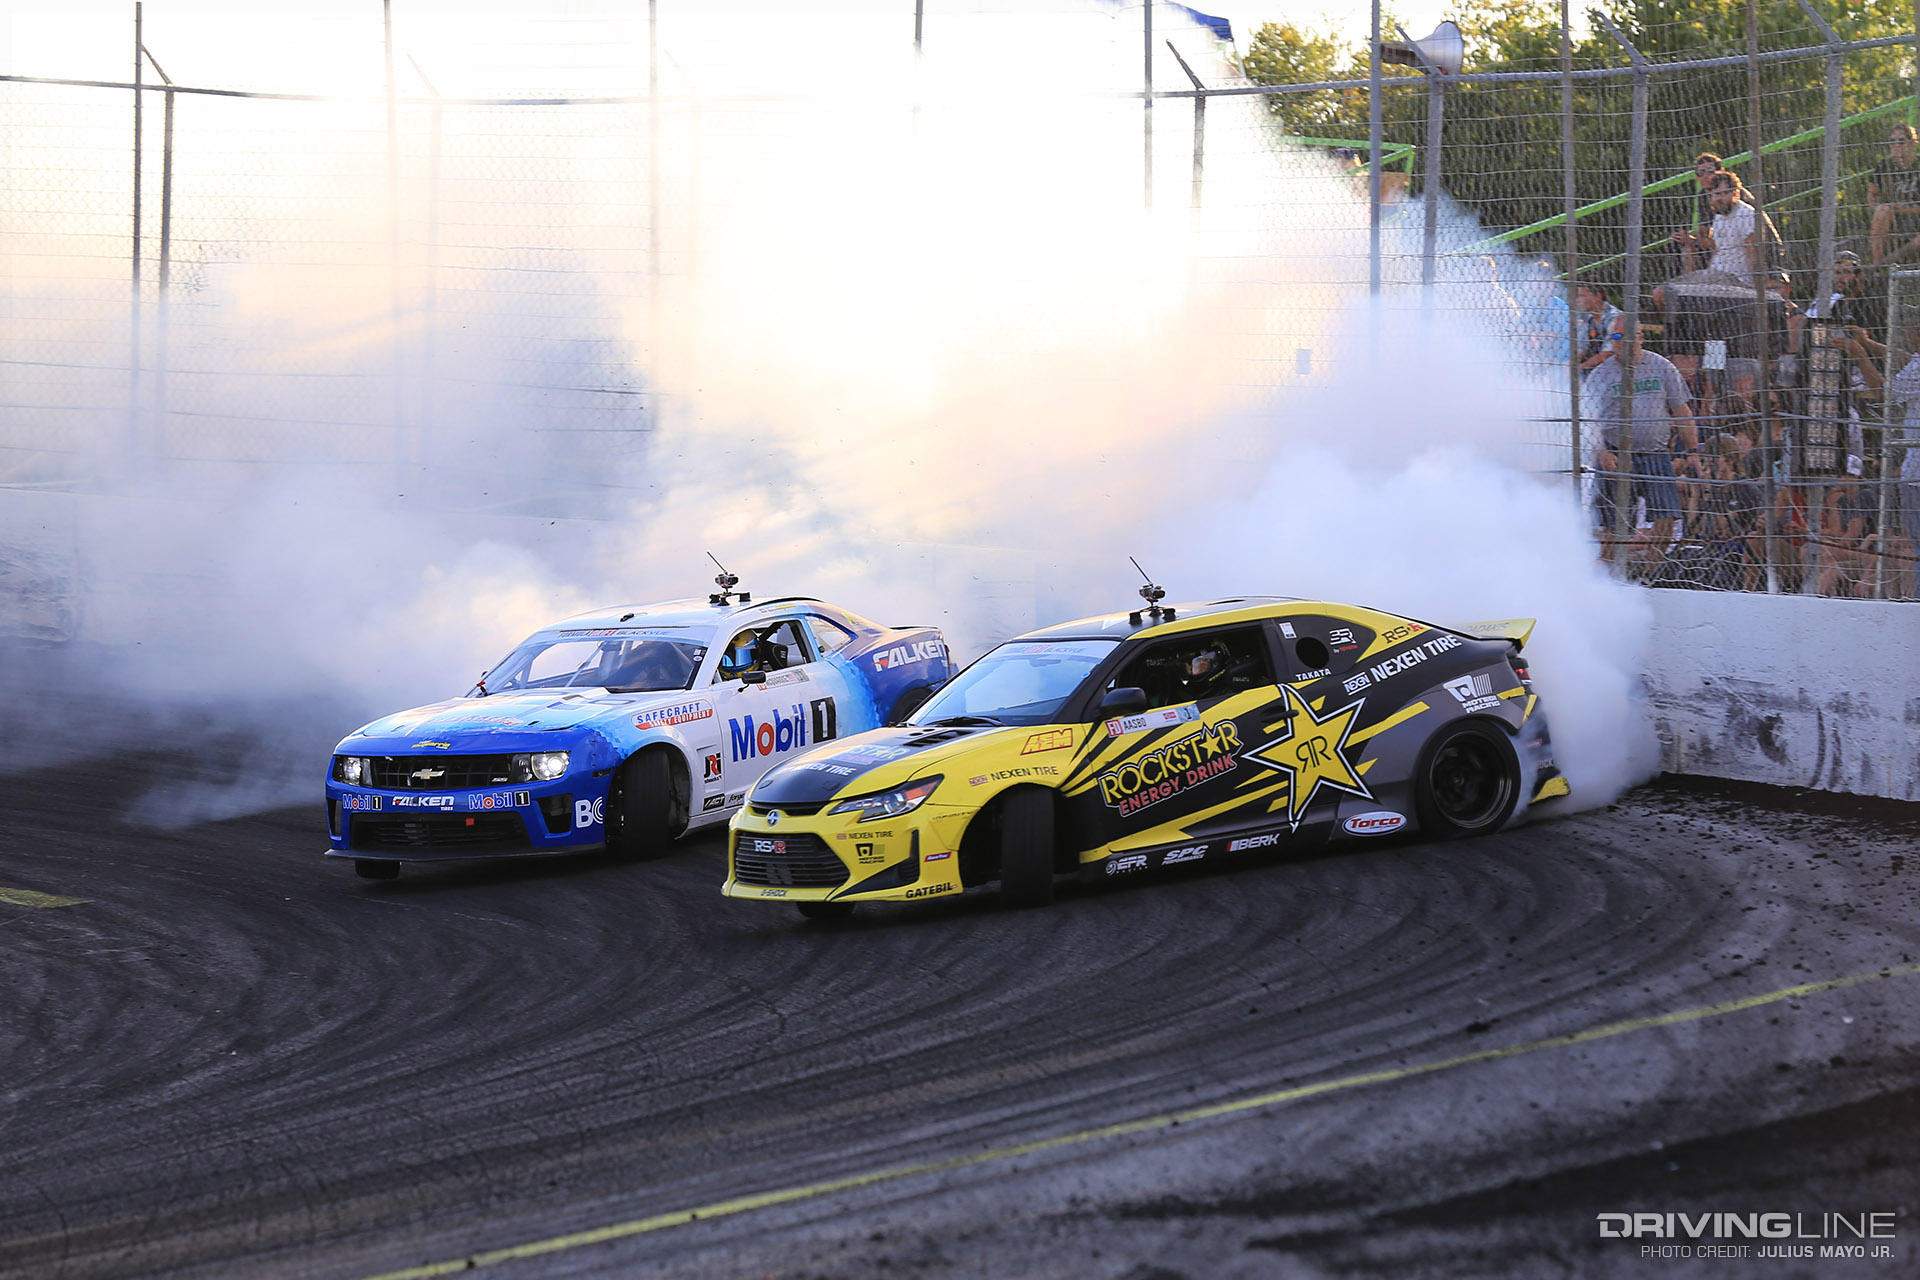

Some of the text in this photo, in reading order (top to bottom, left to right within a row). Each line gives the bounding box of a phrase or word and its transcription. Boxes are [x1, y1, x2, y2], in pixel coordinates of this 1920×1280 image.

[873, 640, 947, 672] FALKEN
[1370, 647, 1427, 682] NEXEN
[1423, 635, 1462, 656] TIRE
[1296, 668, 1331, 680] TAKATA
[1462, 695, 1497, 708] MOTEGI
[1465, 701, 1500, 713] RACING
[637, 702, 700, 724] SAFECRAFT
[674, 709, 710, 724] EQUIPMENT
[728, 703, 806, 762] Mobil
[826, 765, 856, 776] TIRE
[990, 767, 1031, 781] NEXEN
[1032, 766, 1059, 775] TIRE
[1120, 754, 1235, 814] ENERGY DRINK
[342, 794, 371, 810] Mobil
[392, 796, 454, 807] FALKEN
[468, 792, 512, 810] Mobil
[1351, 817, 1401, 828] Torco
[875, 830, 893, 838] TIRE
[1238, 834, 1280, 850] BERK
[1164, 845, 1208, 861] SPC
[906, 882, 952, 899] GATEBIL
